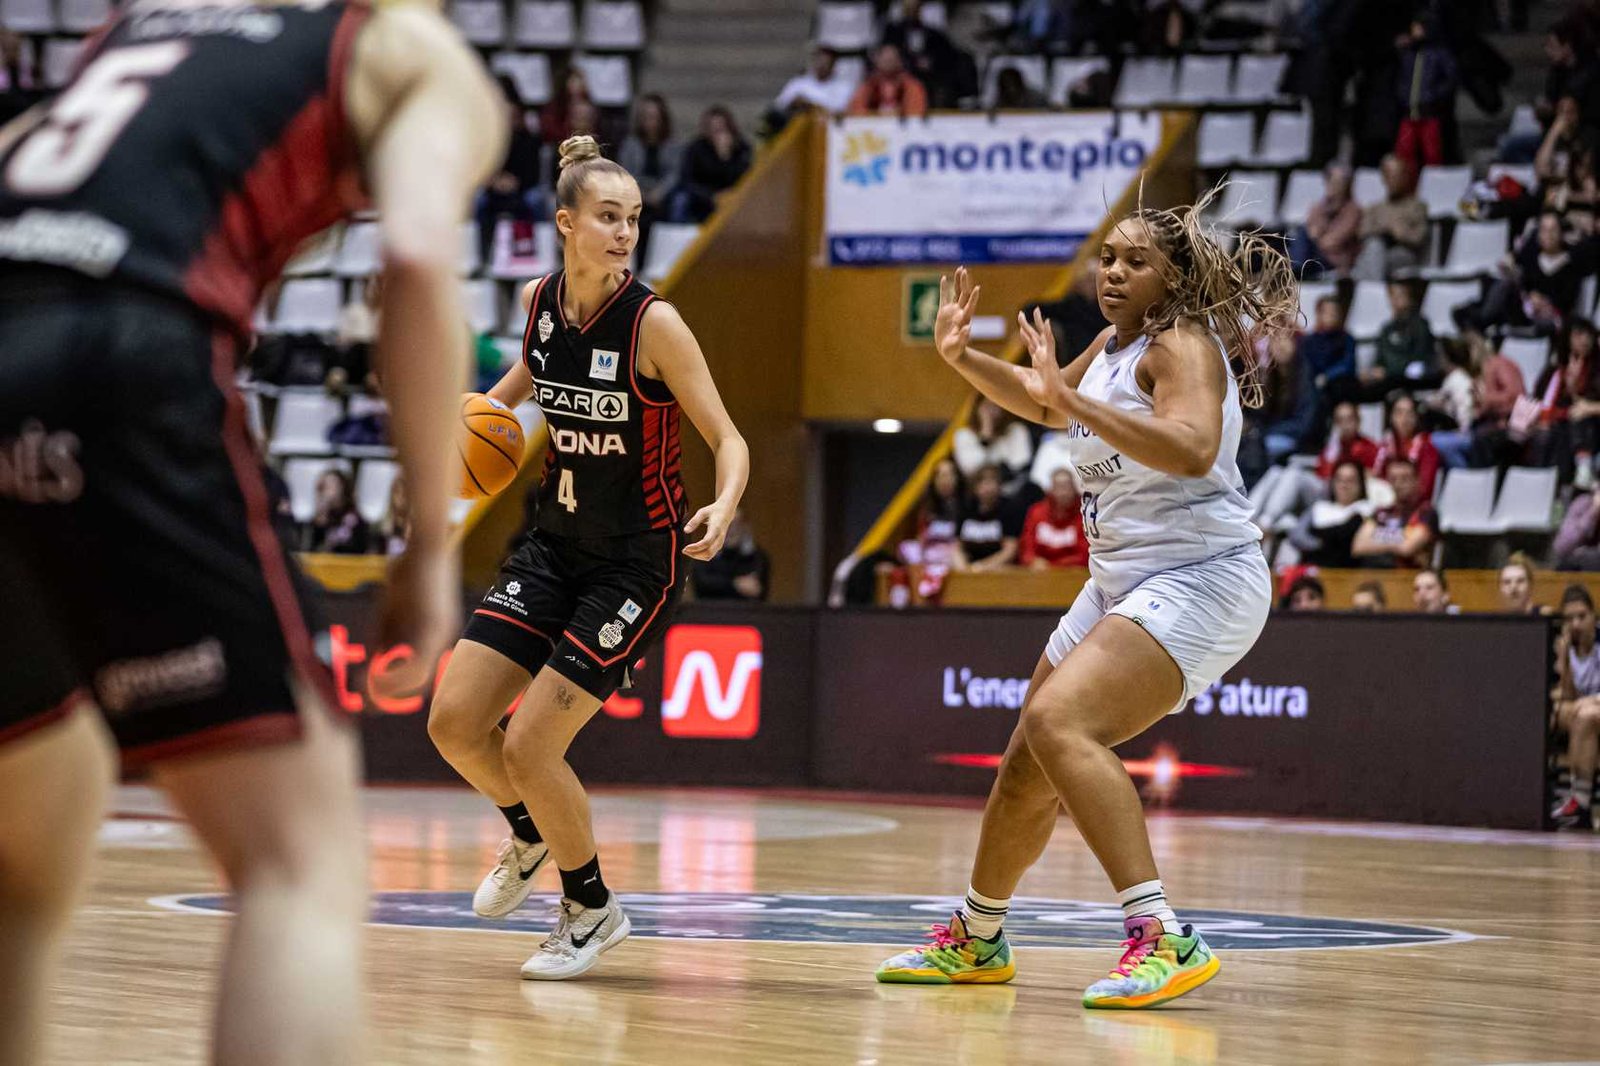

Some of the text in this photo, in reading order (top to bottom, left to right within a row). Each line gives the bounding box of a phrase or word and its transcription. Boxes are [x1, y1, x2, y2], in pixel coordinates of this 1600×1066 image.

[1076, 453, 1122, 476] ENTUT
[558, 469, 577, 513] 4
[510, 603, 528, 616] Girona
[943, 667, 1031, 710] L'ener
